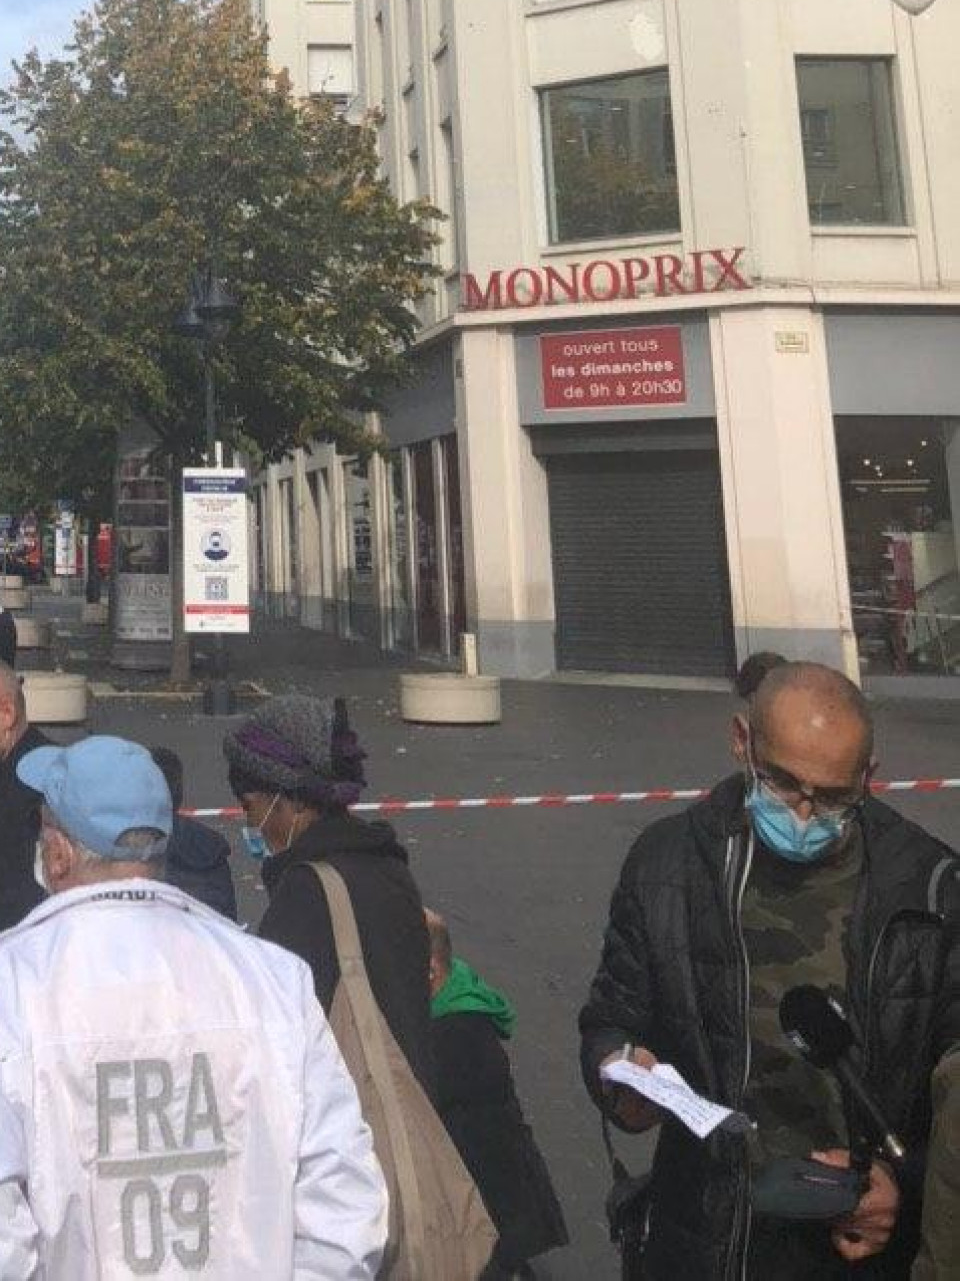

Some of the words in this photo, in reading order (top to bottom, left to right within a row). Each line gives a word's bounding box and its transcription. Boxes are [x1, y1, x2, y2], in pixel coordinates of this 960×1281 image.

[465, 247, 753, 311] MONOPRIX
[563, 340, 616, 356] ouvert
[621, 338, 659, 353] tous
[551, 364, 575, 378] les
[580, 359, 674, 376] dimanches
[563, 385, 584, 399] de
[589, 382, 609, 398] 9h
[616, 380, 626, 396] à
[632, 378, 682, 396] 20h30
[96, 1052, 225, 1154] FRA
[120, 1174, 210, 1275] 09
